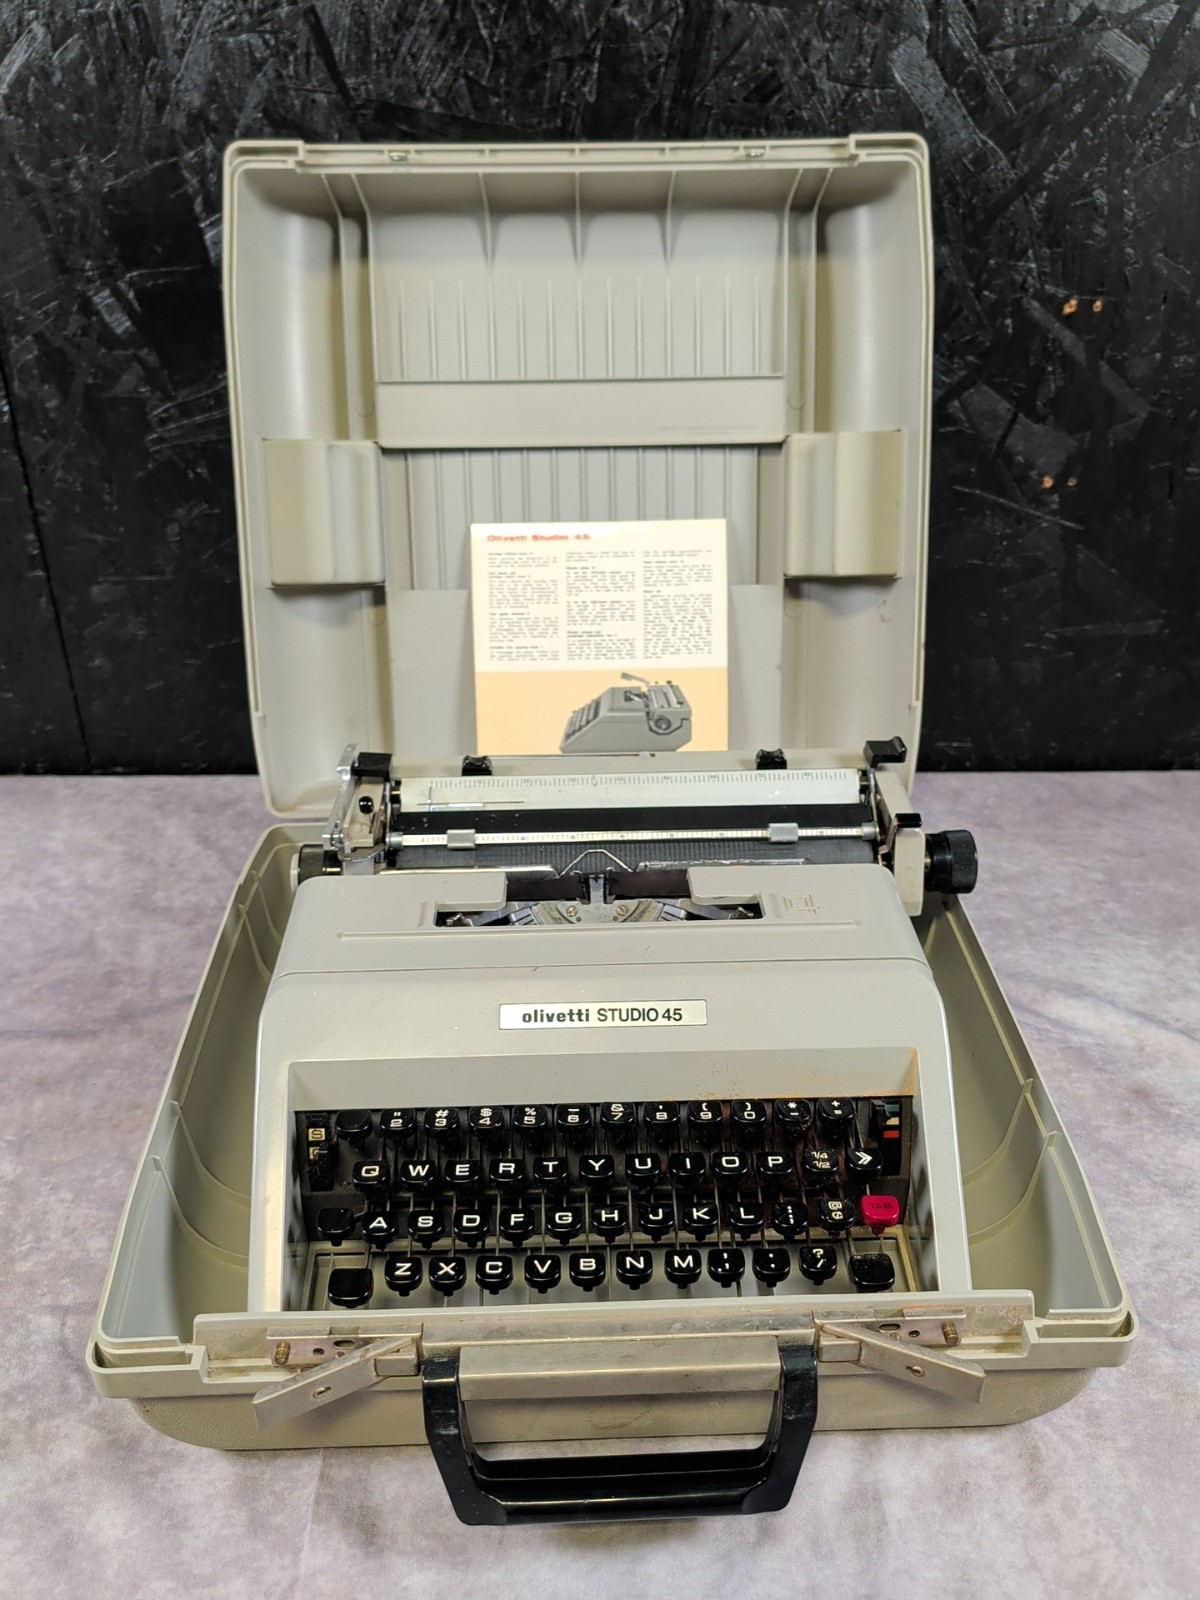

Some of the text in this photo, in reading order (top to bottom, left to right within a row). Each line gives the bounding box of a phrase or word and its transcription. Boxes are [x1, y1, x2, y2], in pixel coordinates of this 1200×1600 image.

[531, 534, 569, 542] Studio
[574, 533, 591, 541] 45
[522, 1008, 683, 1023] olivetti STUDIO 45
[435, 1110, 449, 1118] #
[480, 1108, 493, 1116] $
[525, 1108, 536, 1116] %
[390, 1118, 403, 1127] 2
[435, 1118, 447, 1127] 3
[479, 1117, 491, 1125] 4
[524, 1116, 535, 1124] 5
[311, 1129, 323, 1140] S
[362, 1166, 379, 1176] Q
[409, 1165, 429, 1177] W
[456, 1164, 469, 1175] E
[499, 1163, 515, 1173] R
[543, 1162, 558, 1172] T
[589, 1159, 605, 1170] Y
[635, 1158, 651, 1169] U
[722, 1157, 739, 1167] O
[768, 1156, 783, 1167] P
[369, 1208, 754, 1228] A S D F G H J K L
[813, 1249, 823, 1258] ?
[395, 1255, 693, 1275] Z X C V B N M
[817, 1258, 826, 1267] /
